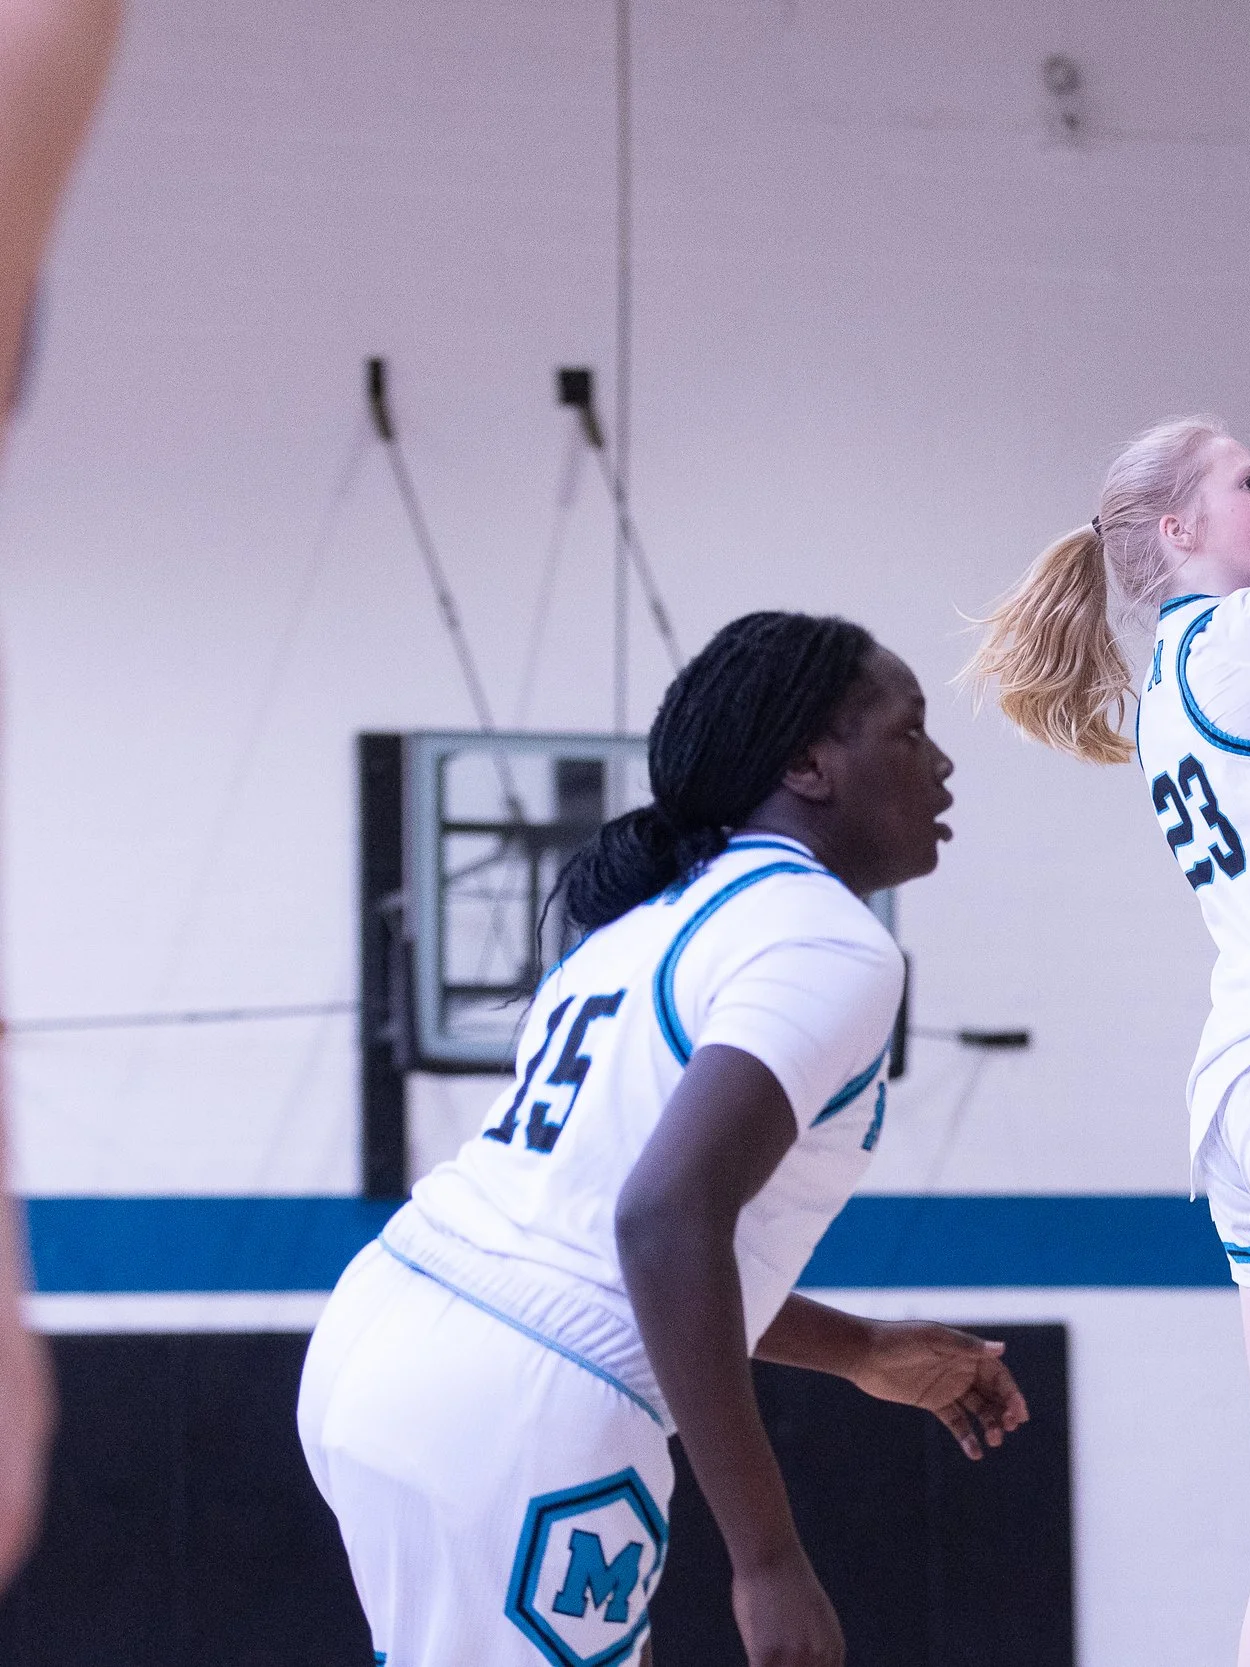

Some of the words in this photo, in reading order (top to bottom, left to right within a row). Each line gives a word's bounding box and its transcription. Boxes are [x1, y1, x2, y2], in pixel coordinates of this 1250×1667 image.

[1152, 752, 1247, 892] 23
[482, 988, 628, 1154] 15
[552, 1528, 644, 1624] M
